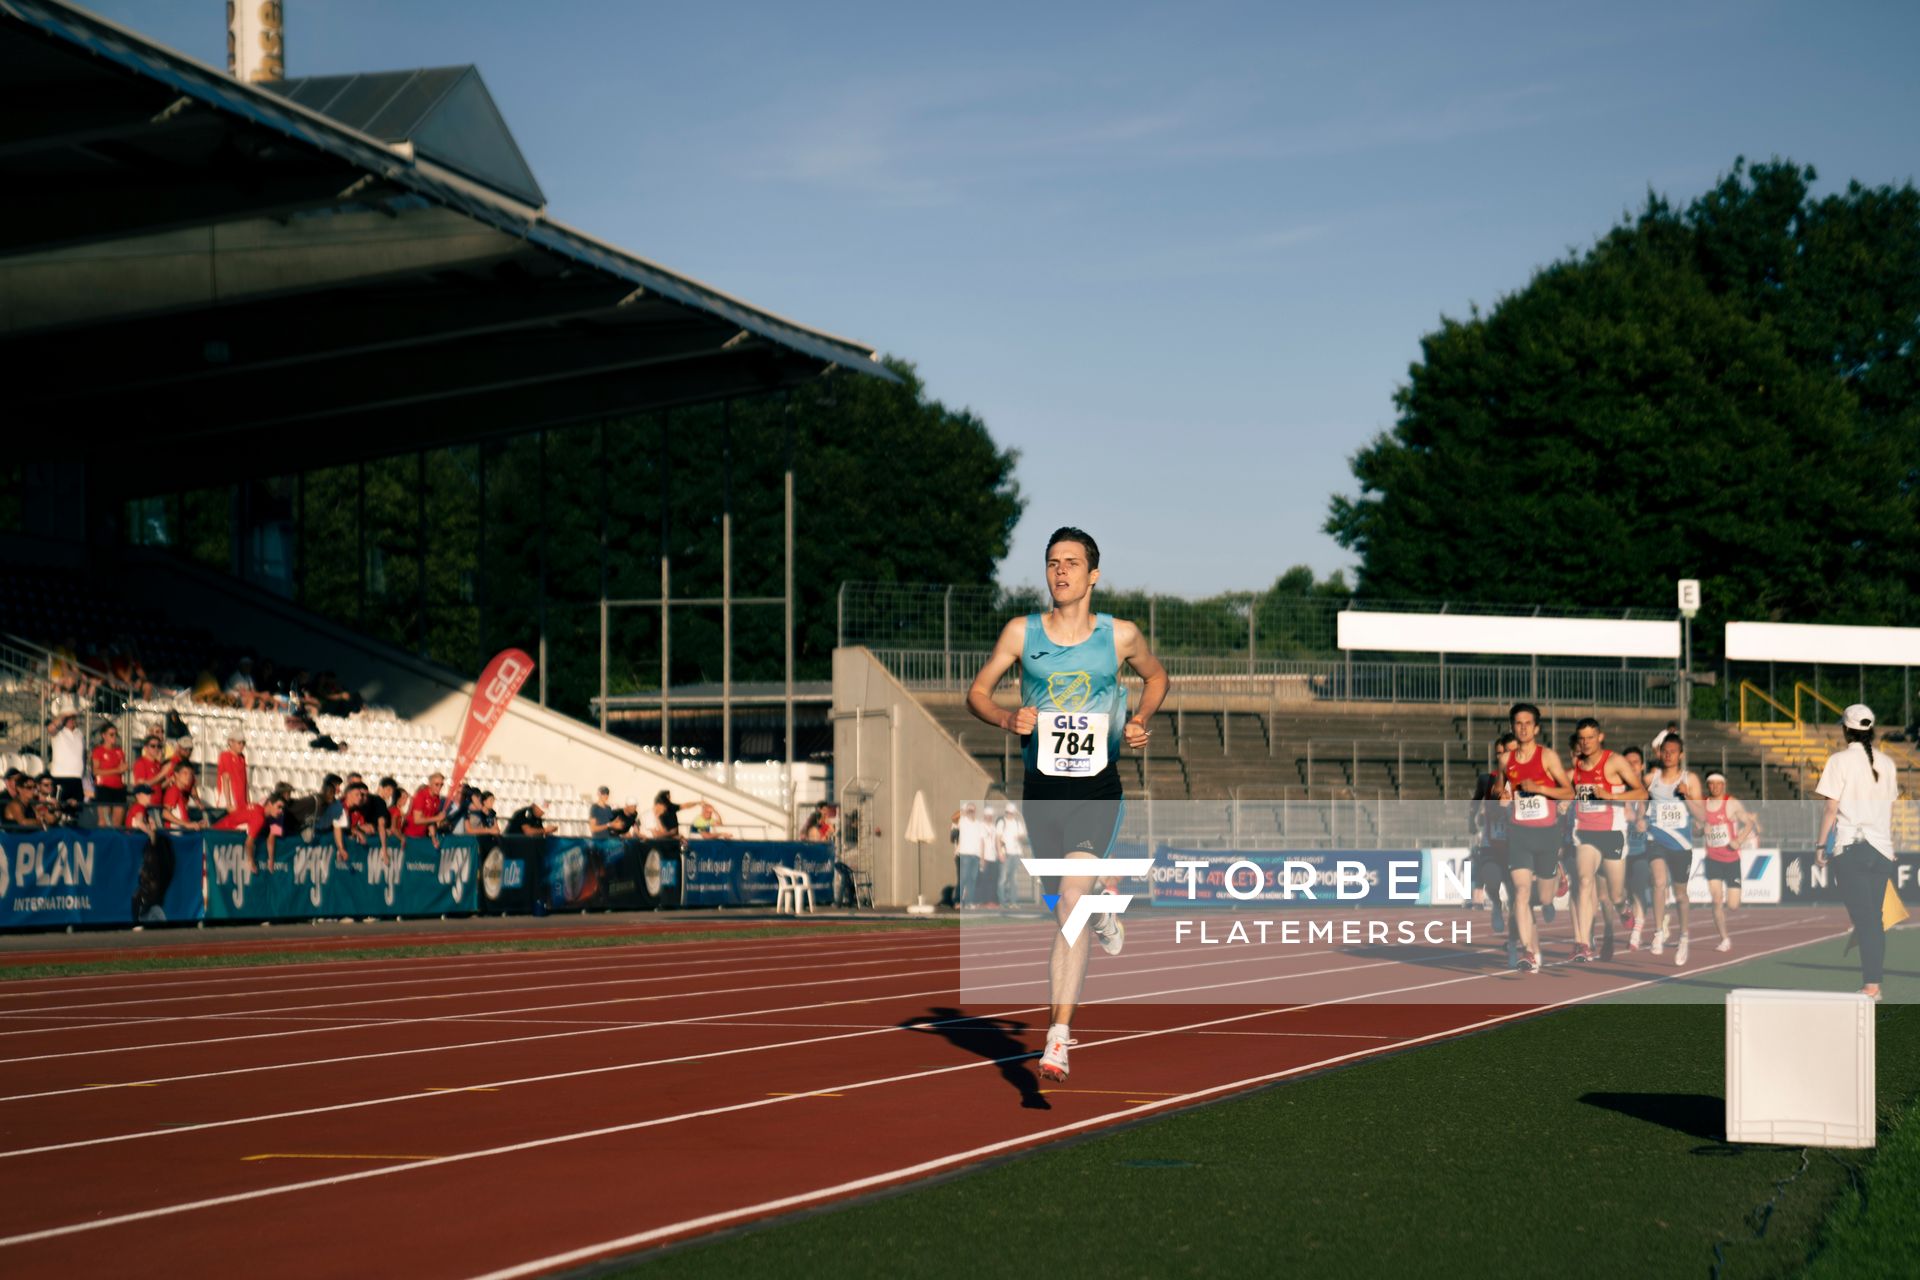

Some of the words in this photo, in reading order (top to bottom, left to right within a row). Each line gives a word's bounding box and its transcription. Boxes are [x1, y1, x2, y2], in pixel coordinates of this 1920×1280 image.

[1684, 585, 1694, 604] E
[472, 658, 520, 724] LGO
[1051, 732, 1095, 756] 784
[1520, 799, 1541, 811] 546
[1661, 811, 1681, 821] 598
[15, 841, 94, 888] PLAN
[13, 895, 91, 912] INTERNATIONAL
